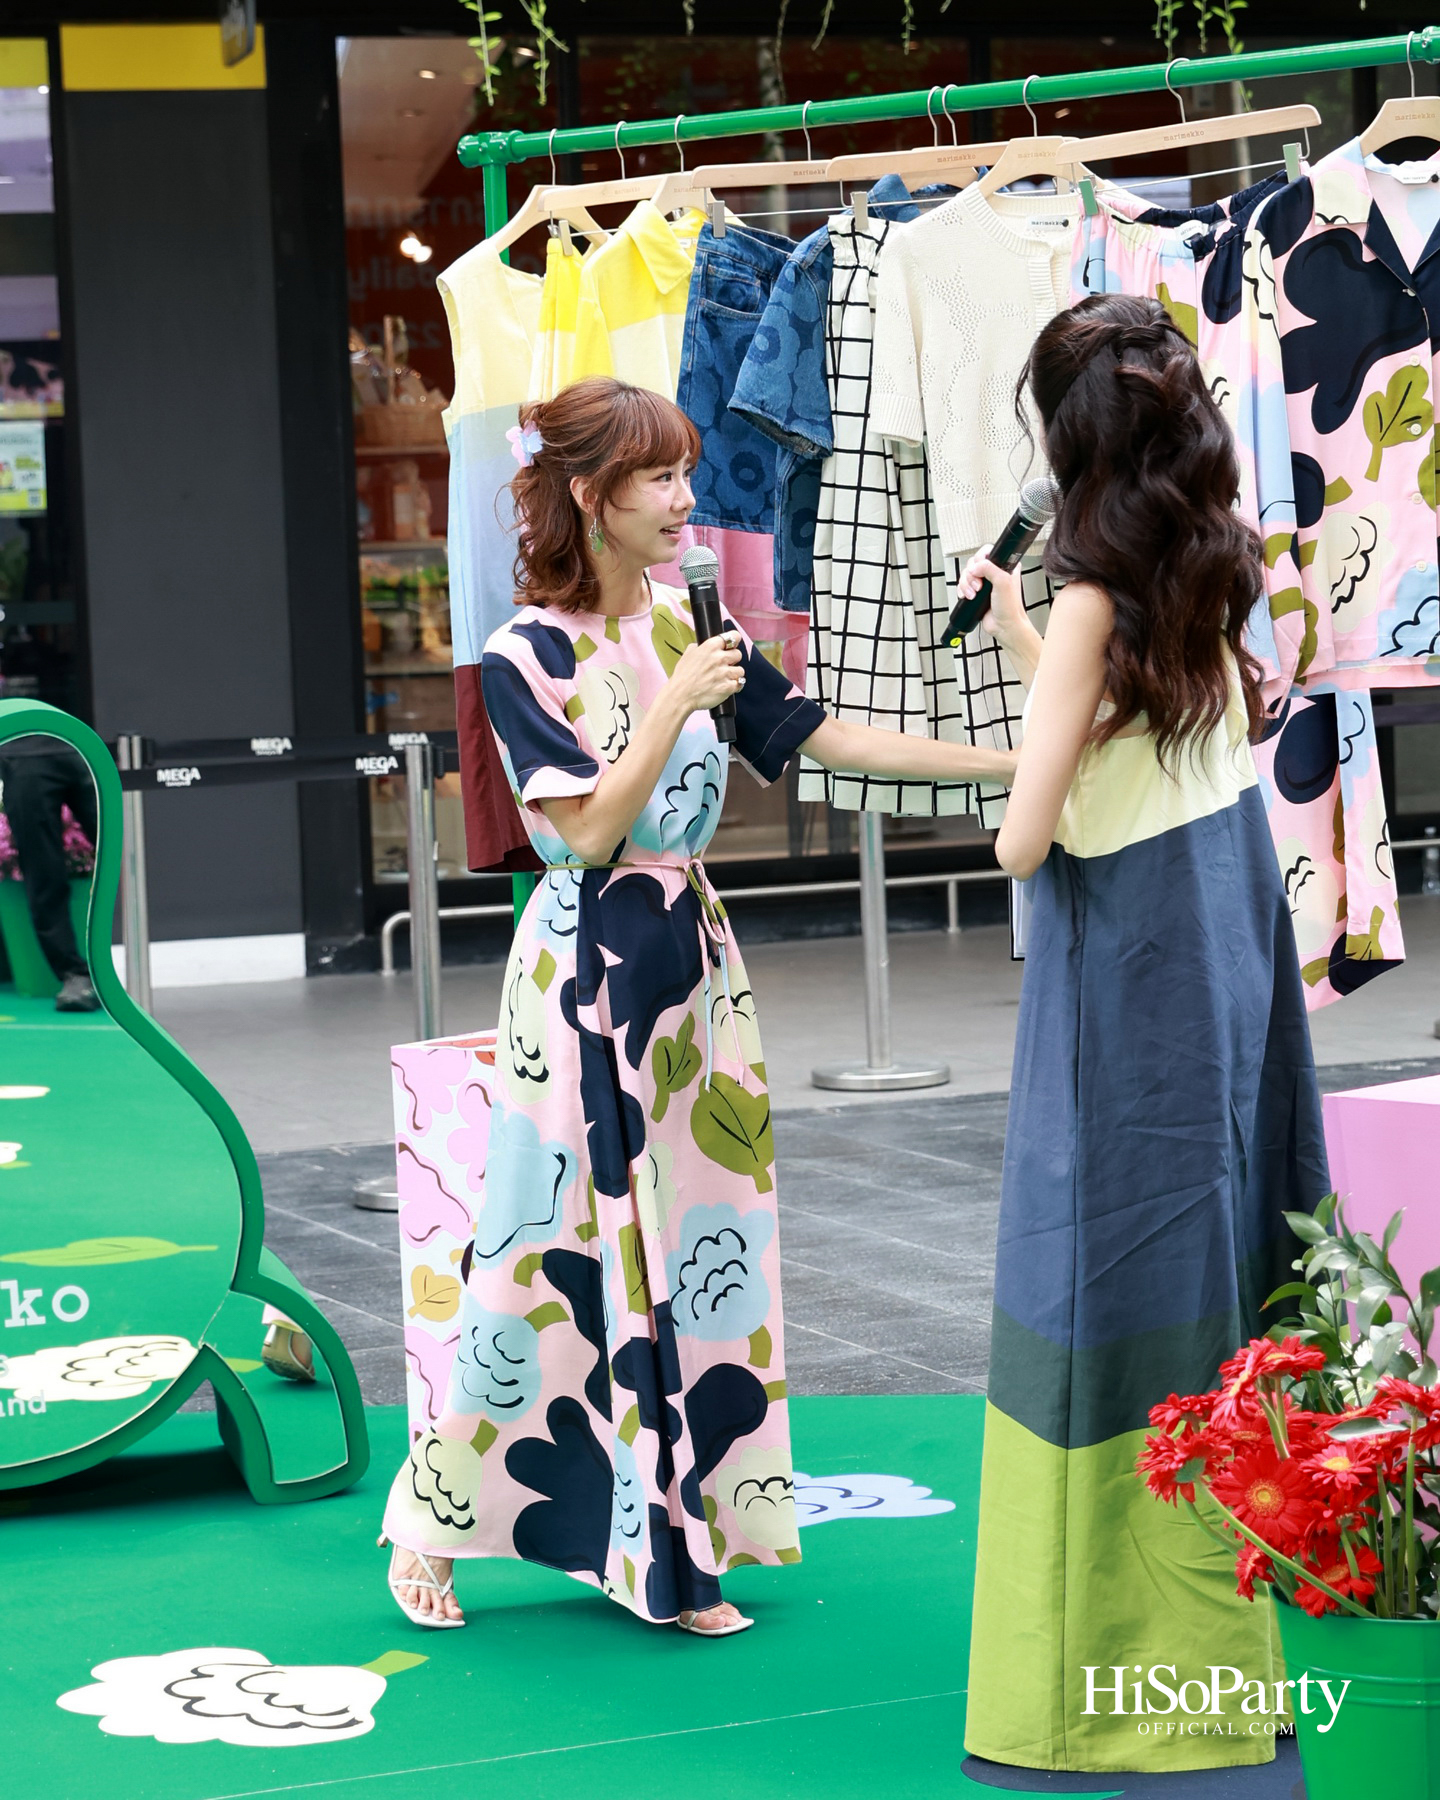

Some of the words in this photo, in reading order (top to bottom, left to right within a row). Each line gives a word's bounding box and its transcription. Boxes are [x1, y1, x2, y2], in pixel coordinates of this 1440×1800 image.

[1395, 112, 1436, 121] marimekko
[1163, 129, 1204, 142] marimekko
[937, 154, 976, 163] marimekko
[1017, 150, 1057, 159] marimekko
[251, 737, 292, 753] MEGA
[388, 732, 429, 746] MEGA
[355, 756, 398, 773] MEGA
[157, 767, 201, 785] MEGA
[0, 1279, 90, 1328] ko
